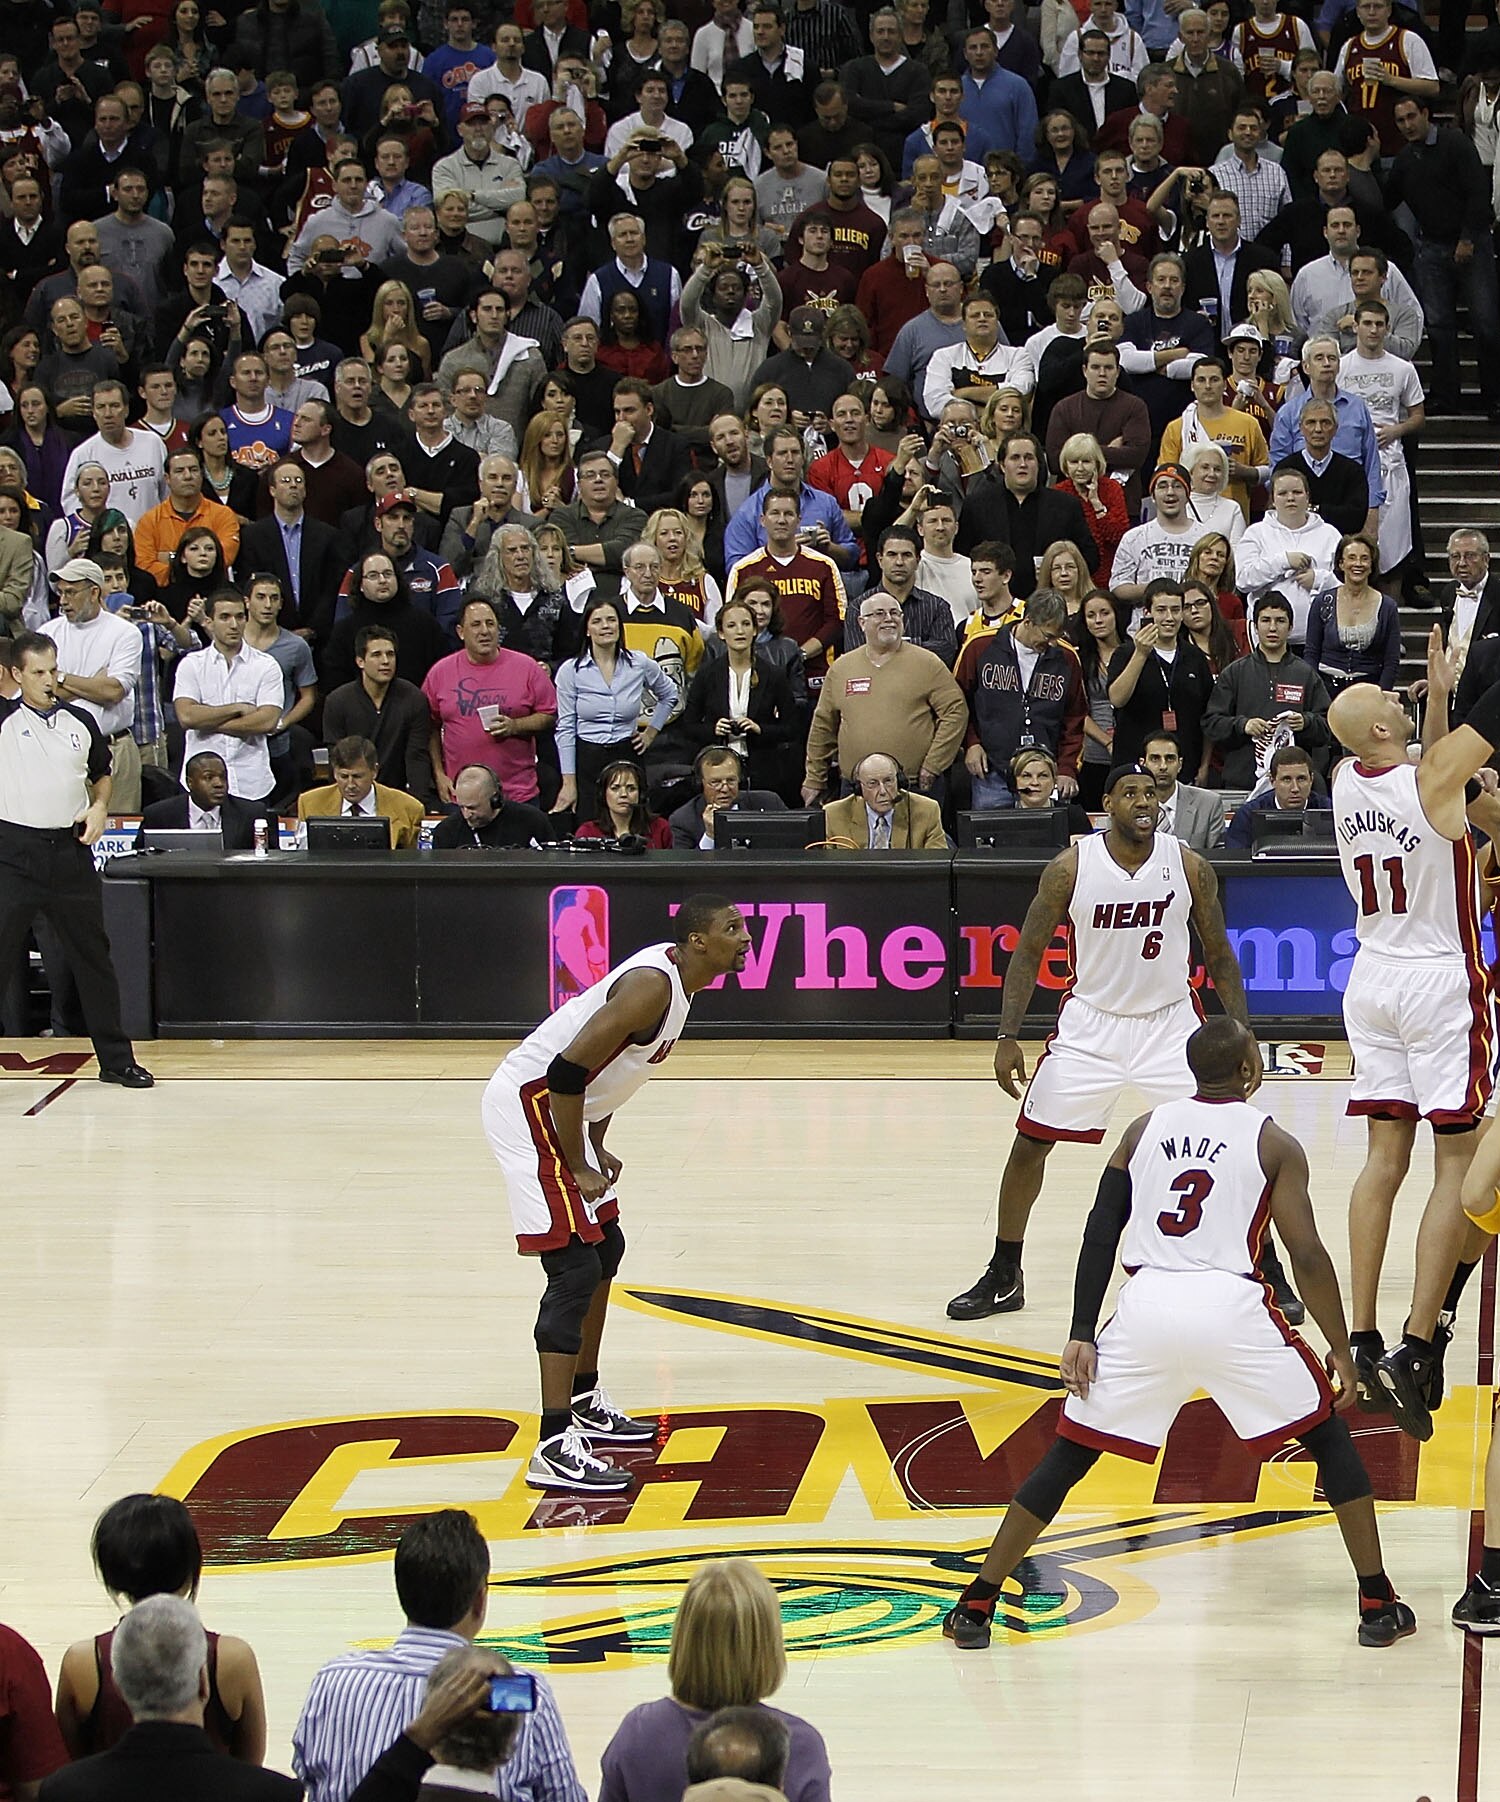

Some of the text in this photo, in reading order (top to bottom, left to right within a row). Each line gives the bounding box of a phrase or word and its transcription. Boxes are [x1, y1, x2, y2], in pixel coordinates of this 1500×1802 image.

[1361, 80, 1379, 108] 17
[835, 227, 869, 250] ALIERS
[108, 467, 155, 483] AVALIERS
[1337, 809, 1421, 853] ILGAUSKAS
[93, 840, 126, 853] ARK
[1353, 854, 1408, 917] 11
[1092, 889, 1176, 930] HEAT
[1141, 930, 1164, 961] 6
[1160, 1136, 1228, 1164] WADE
[1156, 1168, 1215, 1238] 3
